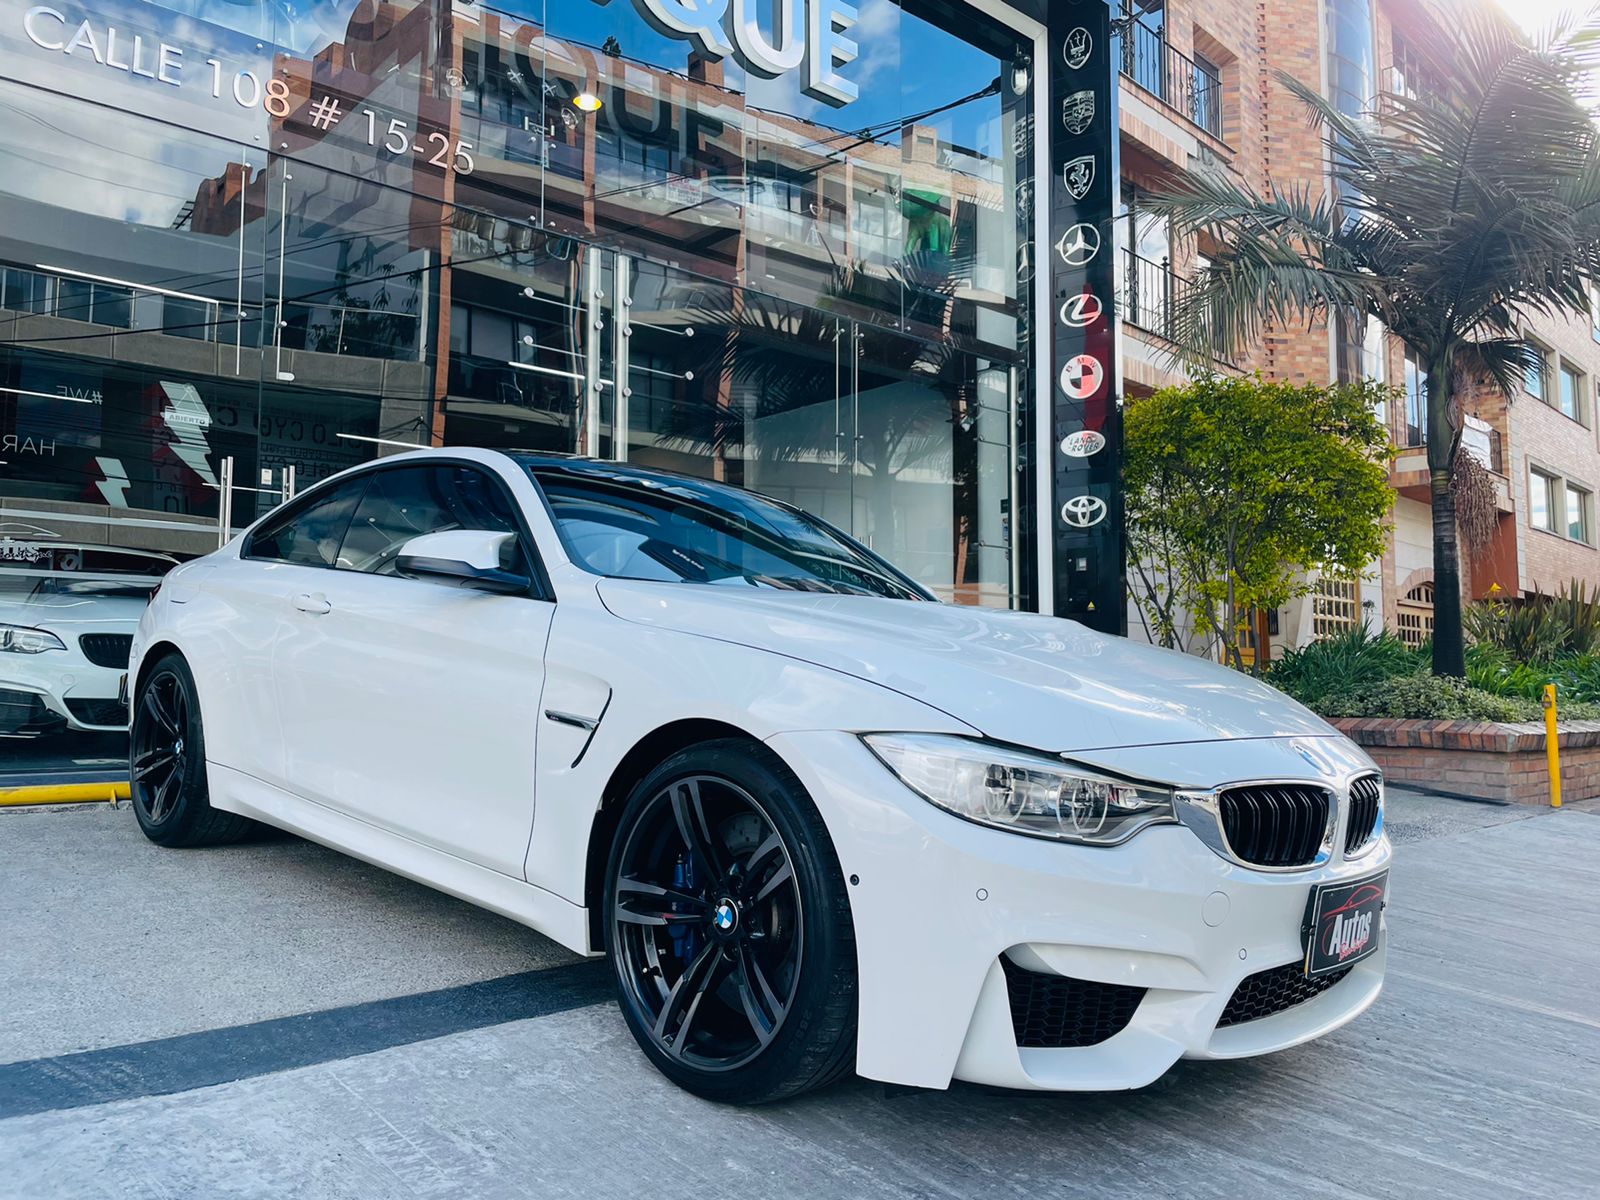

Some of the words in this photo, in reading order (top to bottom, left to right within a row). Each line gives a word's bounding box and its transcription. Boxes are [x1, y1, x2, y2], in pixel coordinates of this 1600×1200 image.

[23, 5, 183, 87] CALLE
[206, 58, 291, 119] 108
[308, 95, 342, 131] #
[362, 109, 475, 176] 15-25
[1071, 442, 1100, 453] ROVER
[1328, 910, 1372, 956] Autos
